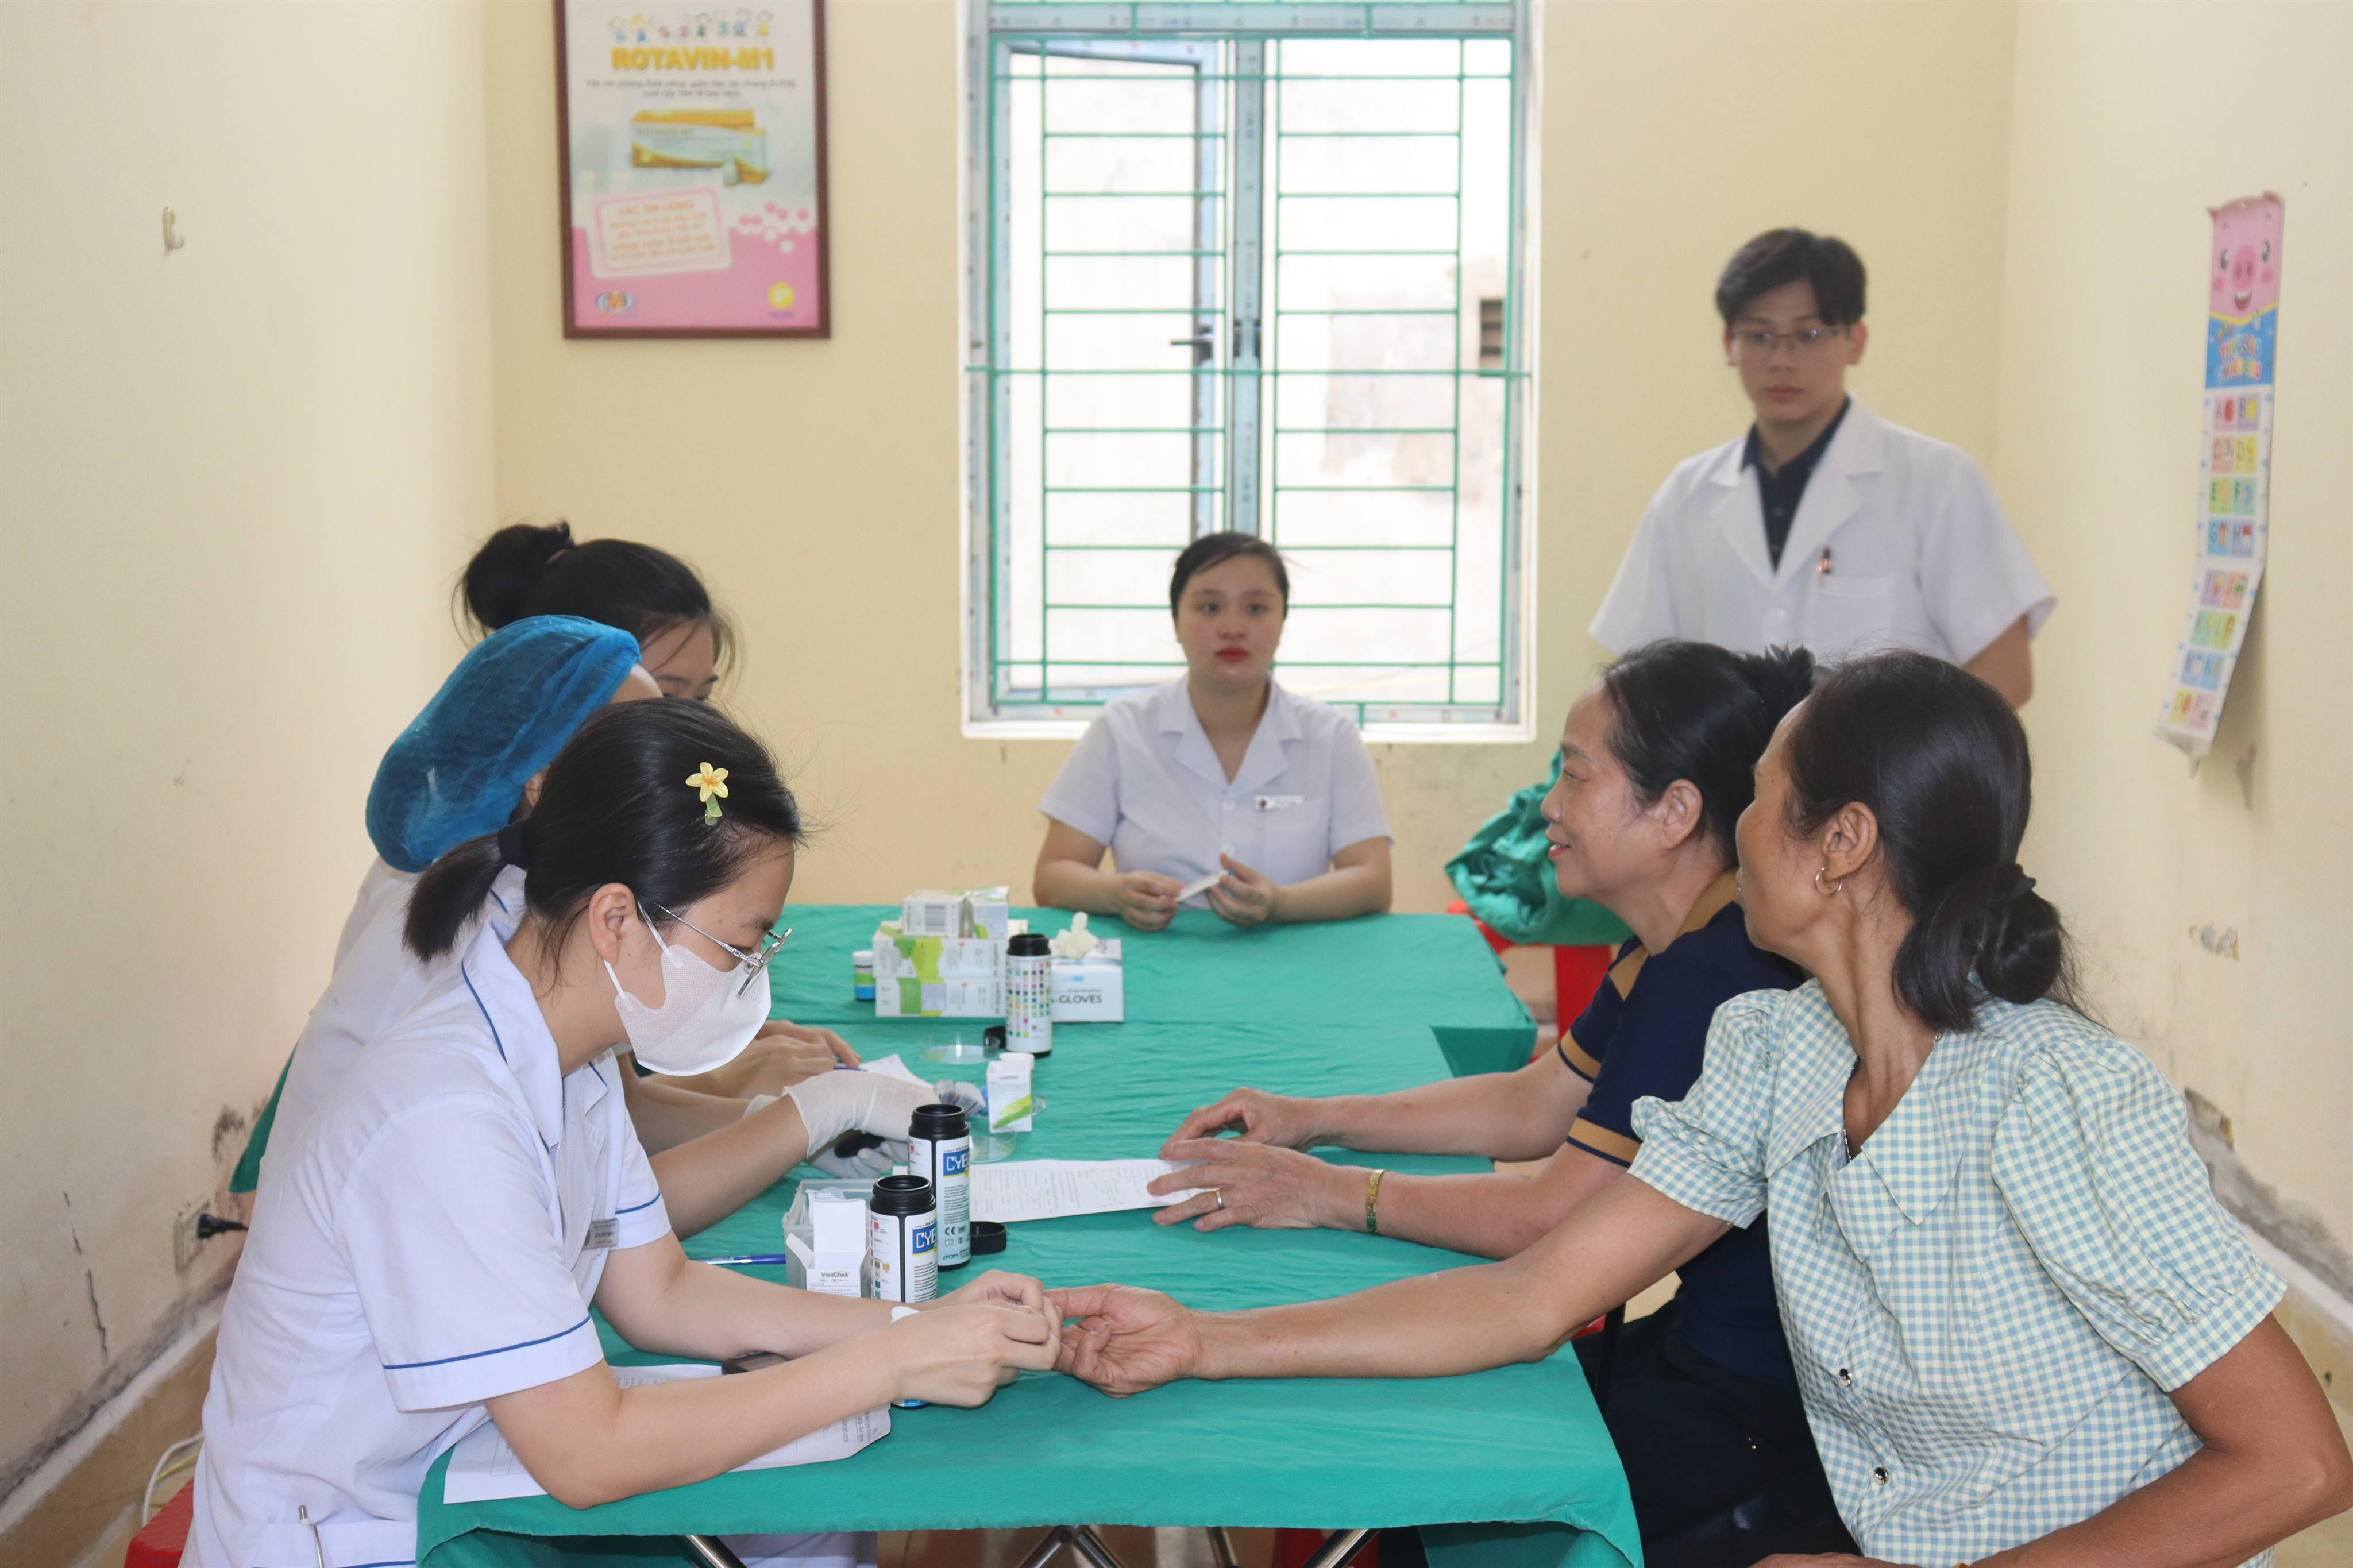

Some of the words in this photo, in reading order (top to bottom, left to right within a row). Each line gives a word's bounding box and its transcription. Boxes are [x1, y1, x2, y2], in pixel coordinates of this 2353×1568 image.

[612, 47, 774, 69] ROTAVIN-M1
[2239, 397, 2246, 418] B
[2212, 481, 2217, 501] E
[2235, 482, 2240, 501] F
[1059, 995, 1102, 1004] GLOVES
